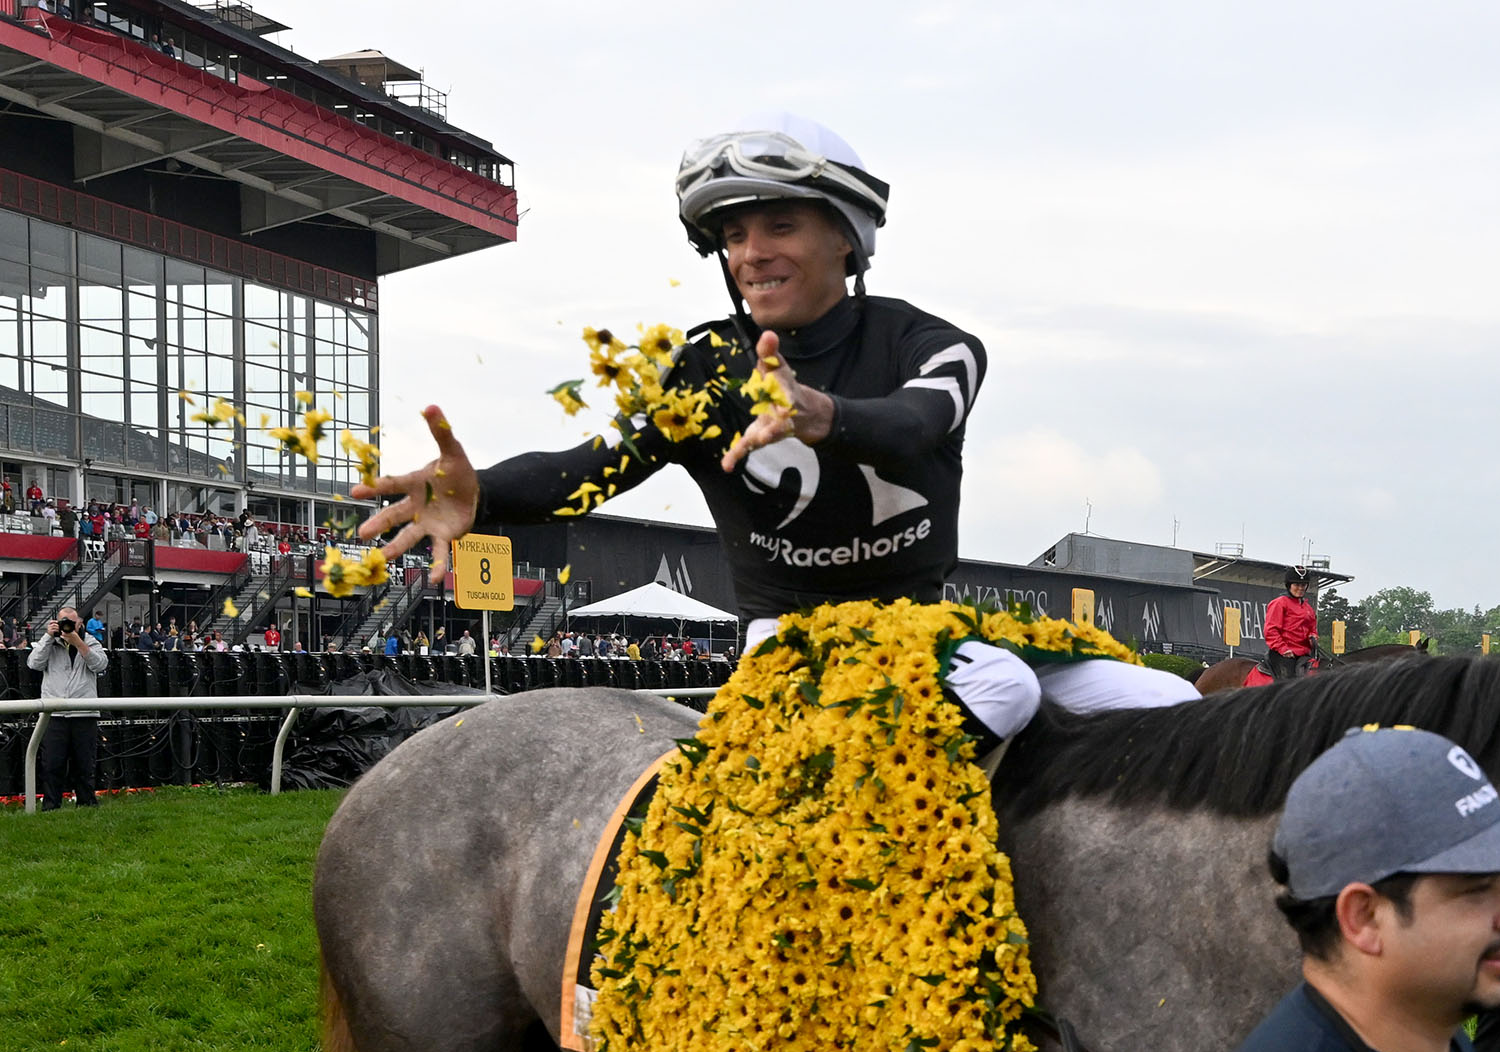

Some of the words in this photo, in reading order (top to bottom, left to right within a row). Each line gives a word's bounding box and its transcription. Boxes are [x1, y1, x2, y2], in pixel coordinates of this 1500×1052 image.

[465, 541, 510, 555] PREAKNESS
[750, 518, 931, 567] myRacehorse
[480, 557, 491, 585] 8
[466, 591, 489, 600] TUSCAN
[490, 592, 505, 601] GOLD
